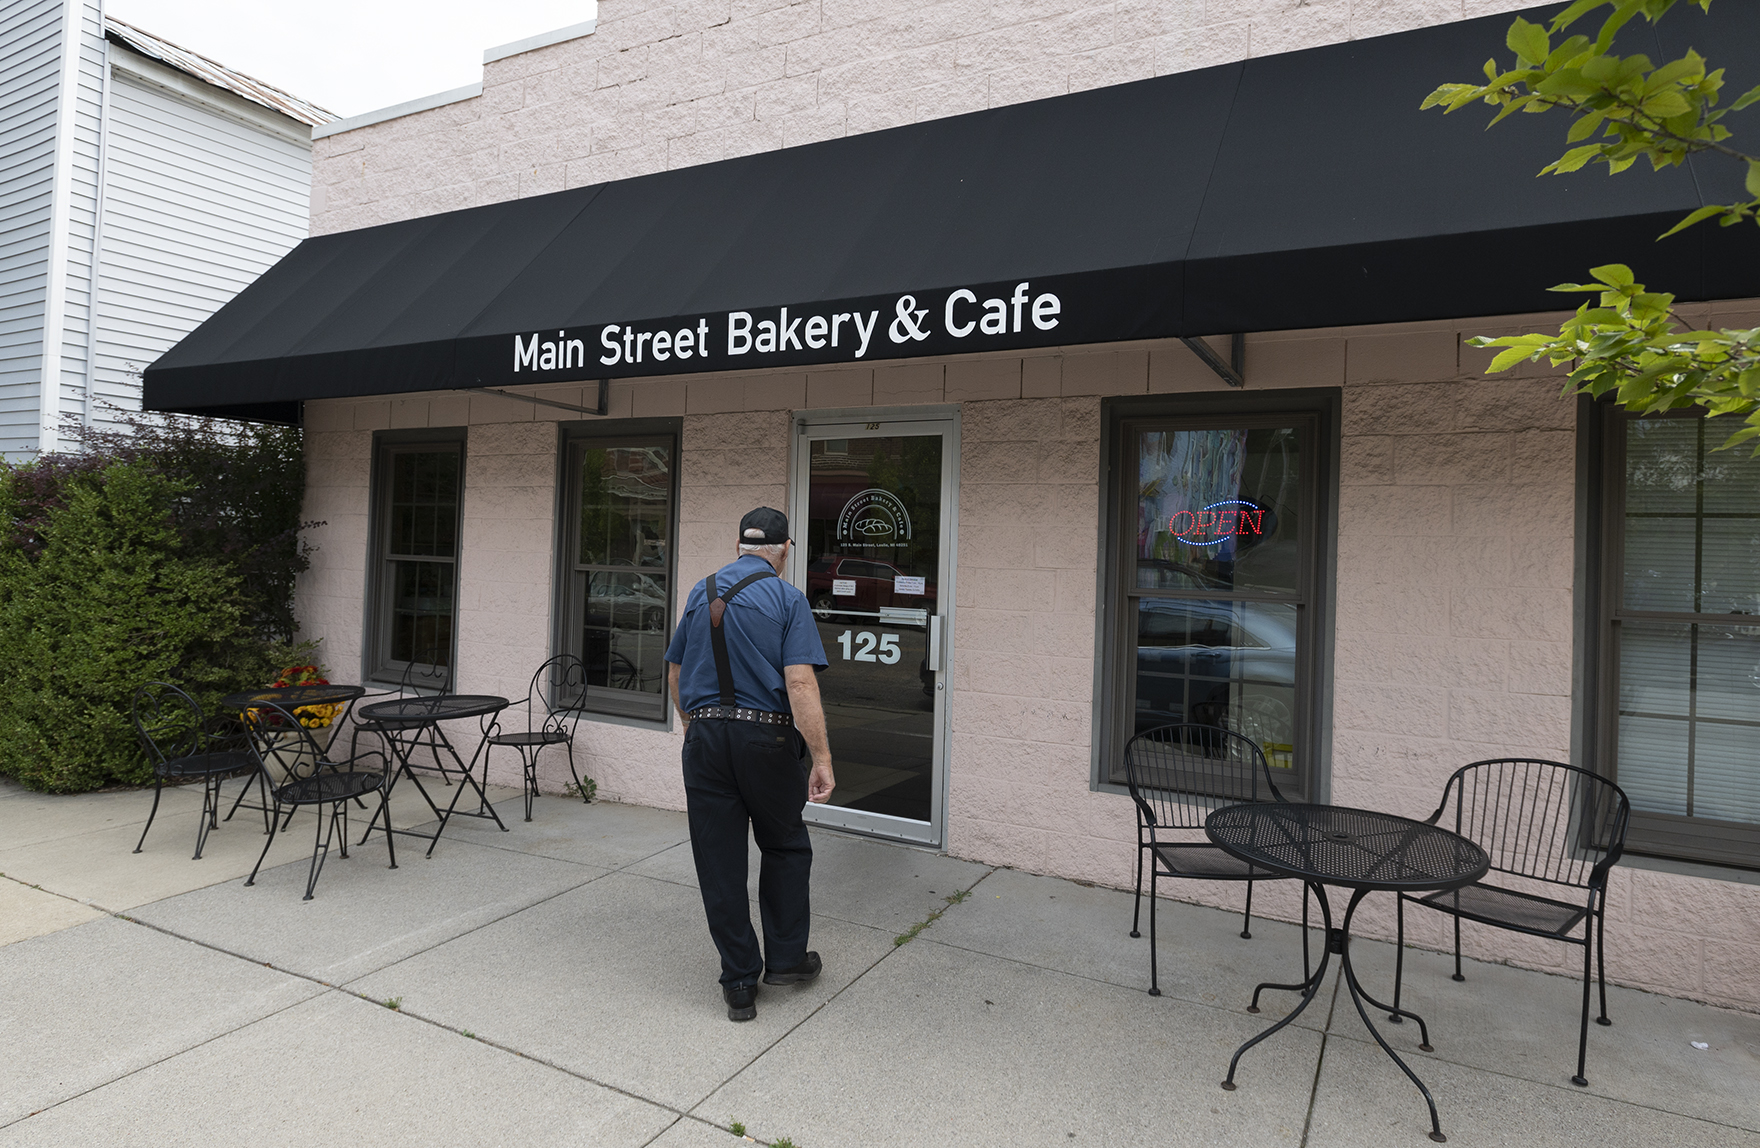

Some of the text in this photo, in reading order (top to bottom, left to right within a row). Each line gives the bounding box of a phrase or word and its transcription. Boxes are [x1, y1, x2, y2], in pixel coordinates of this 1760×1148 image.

[514, 281, 1061, 373] Main Street Bakery & Cafe
[842, 511, 853, 529] Main
[850, 496, 869, 511] Street
[870, 495, 892, 508] Bakery
[896, 512, 904, 528] Cafe
[1169, 510, 1265, 536] OPEN
[837, 630, 901, 665] 125
